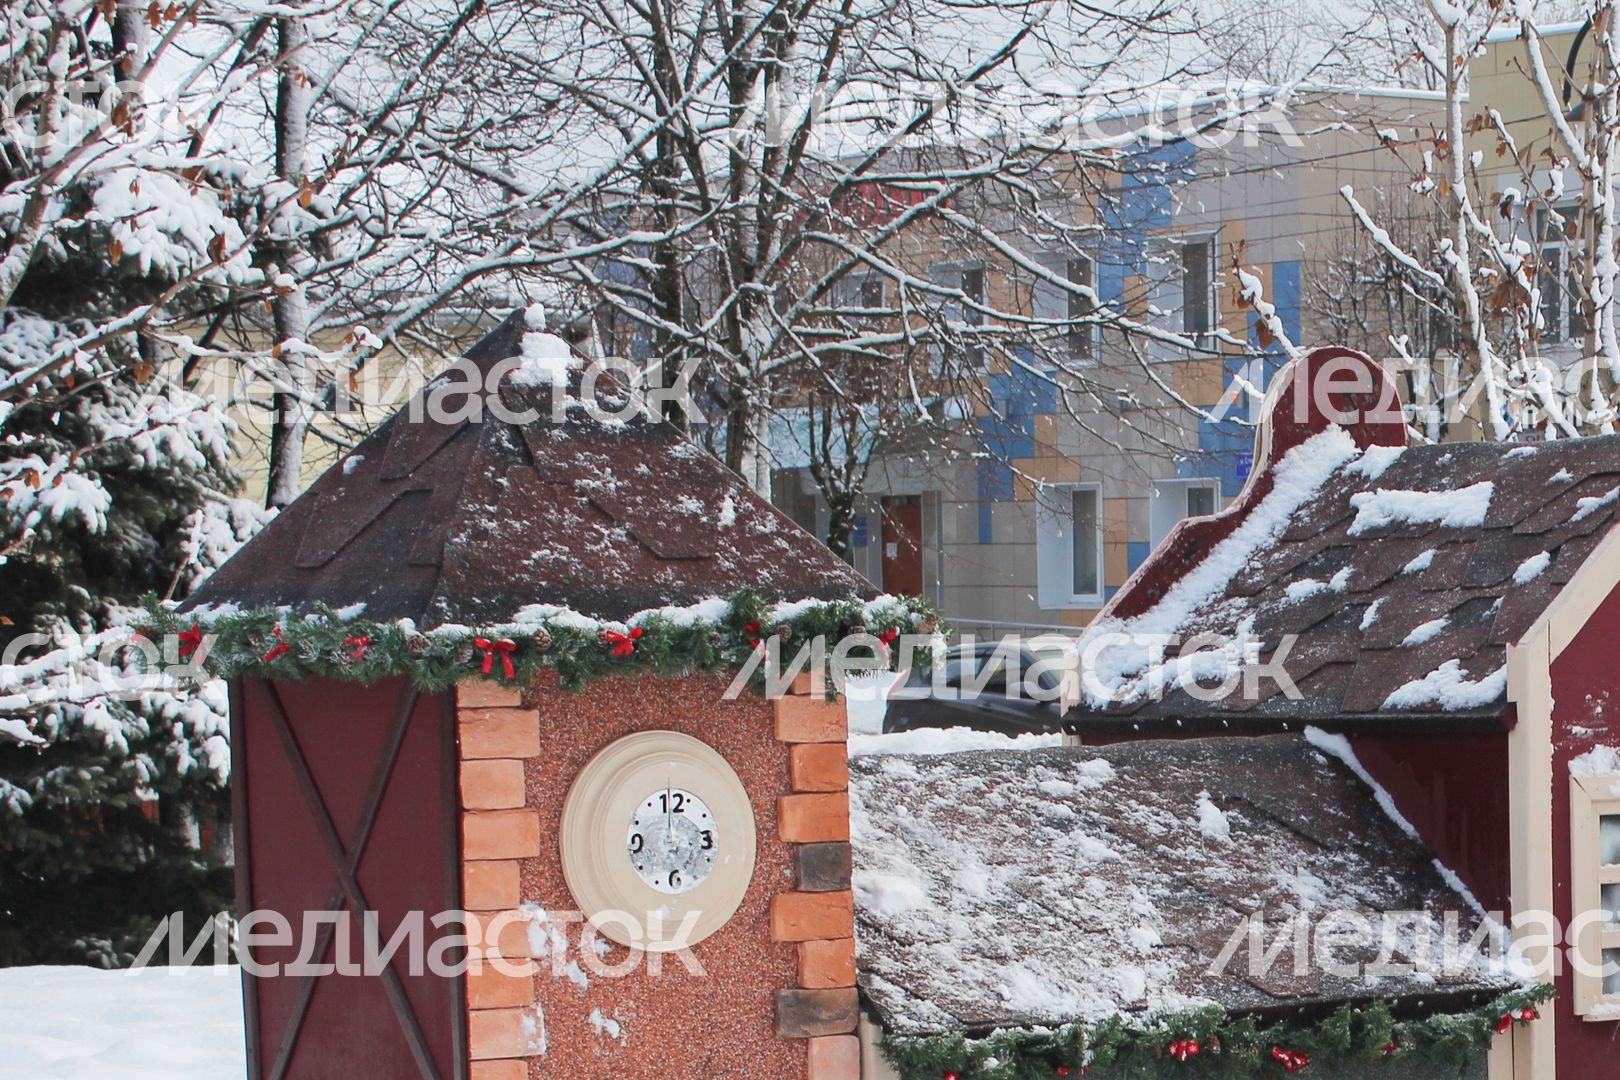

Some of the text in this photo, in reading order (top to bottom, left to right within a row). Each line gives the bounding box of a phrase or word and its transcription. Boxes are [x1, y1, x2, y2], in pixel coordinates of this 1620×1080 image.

[659, 793, 684, 814] 12
[630, 833, 644, 854] 9
[700, 829, 713, 850] 3
[668, 869, 682, 889] 6
